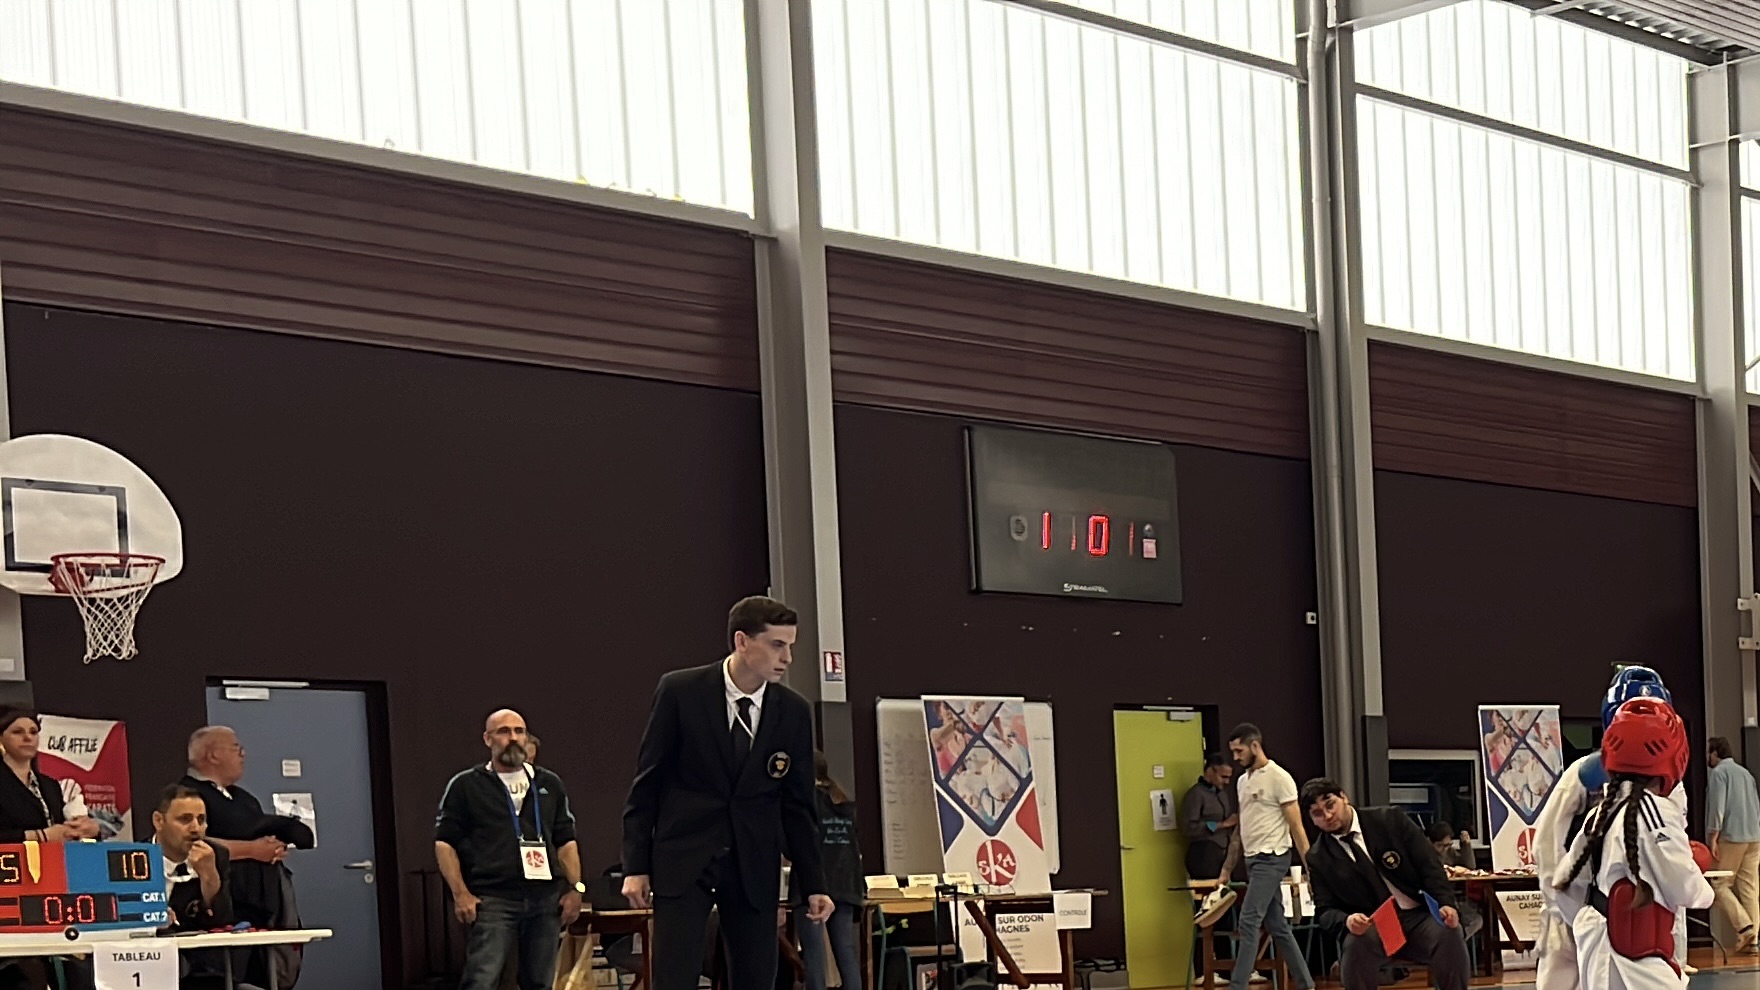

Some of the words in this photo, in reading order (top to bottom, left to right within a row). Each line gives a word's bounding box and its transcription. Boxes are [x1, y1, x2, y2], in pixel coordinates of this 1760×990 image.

[122, 851, 149, 880] 10
[997, 916, 1015, 924] SUR
[1017, 914, 1044, 923] ODON
[112, 952, 161, 962] TABLEAU
[132, 972, 141, 988] 1
